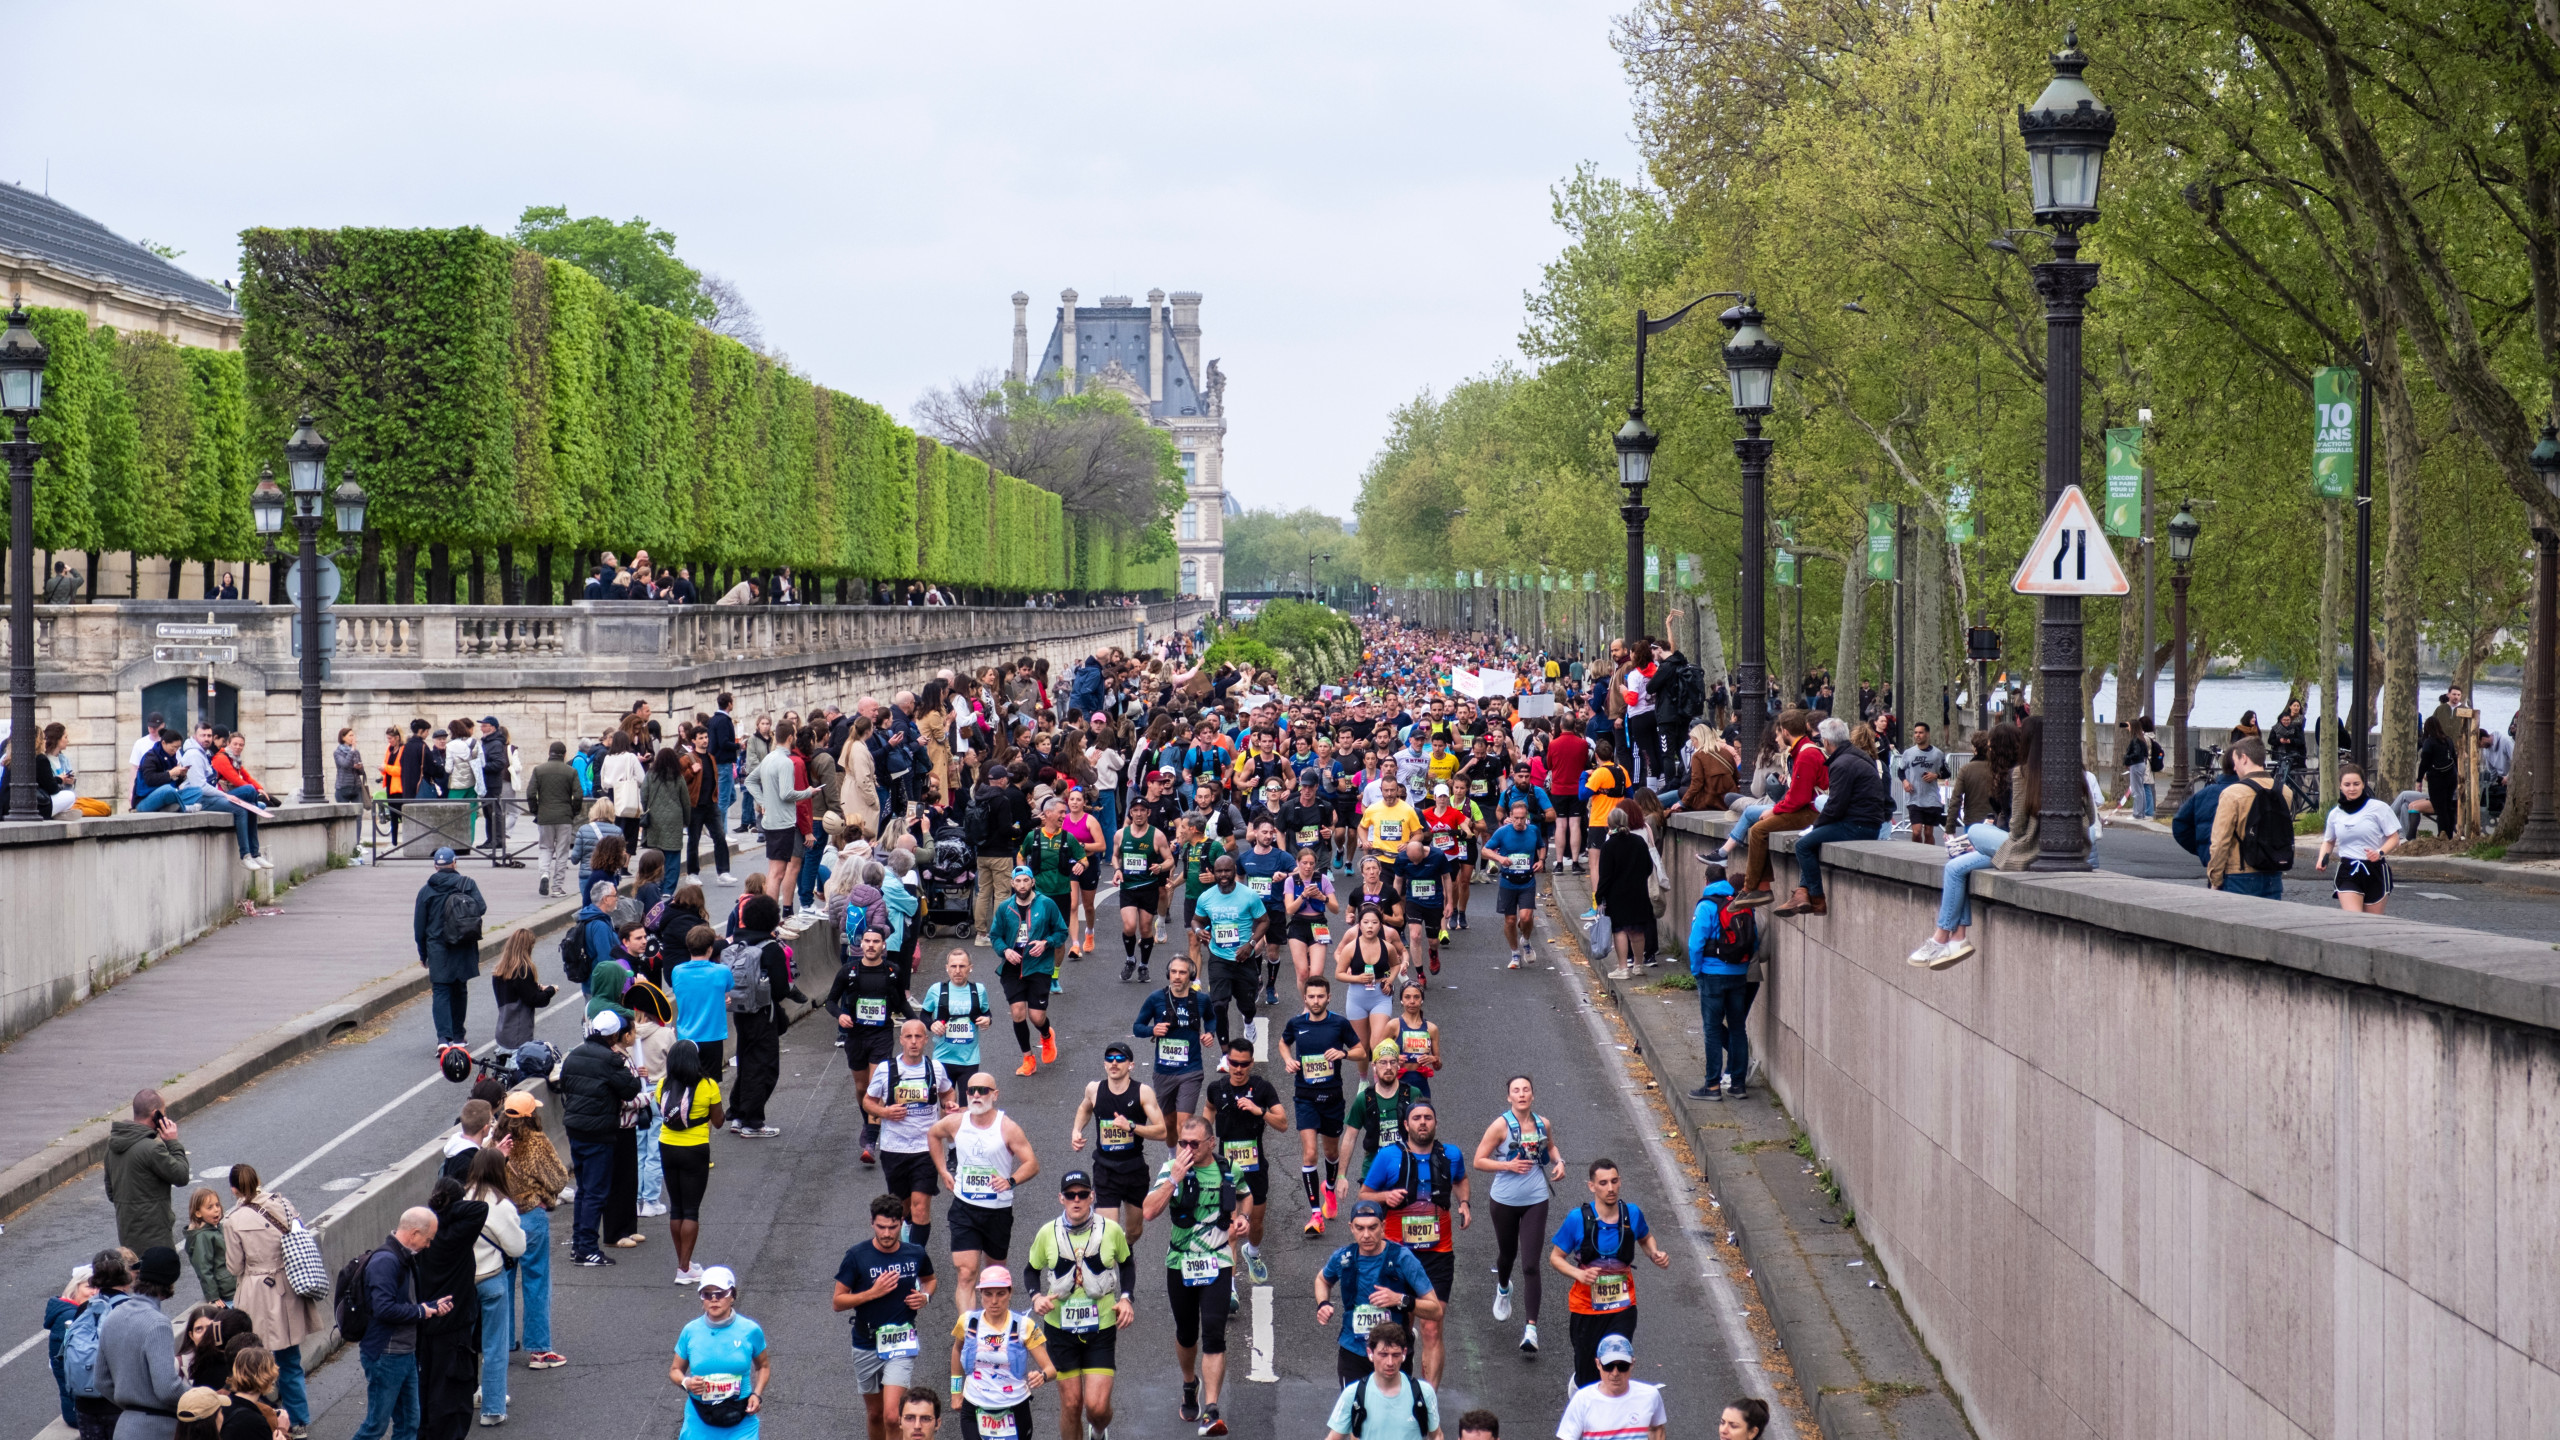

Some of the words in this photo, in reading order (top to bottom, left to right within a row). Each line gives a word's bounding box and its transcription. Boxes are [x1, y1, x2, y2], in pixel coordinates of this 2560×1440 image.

[2318, 402, 2352, 428] 10
[2318, 427, 2352, 441] ANS
[1645, 556, 1659, 566] 10
[1212, 912, 1239, 920] RATP
[948, 1023, 969, 1033] 20986
[899, 1088, 921, 1099] 27198
[1103, 1128, 1127, 1139] 30456
[965, 1175, 990, 1187] 48563
[1407, 1225, 1432, 1236] 49207
[1186, 1259, 1209, 1272] 31981
[1597, 1283, 1621, 1297] 48129
[1065, 1307, 1090, 1320] 27108
[881, 1331, 908, 1345] 34033
